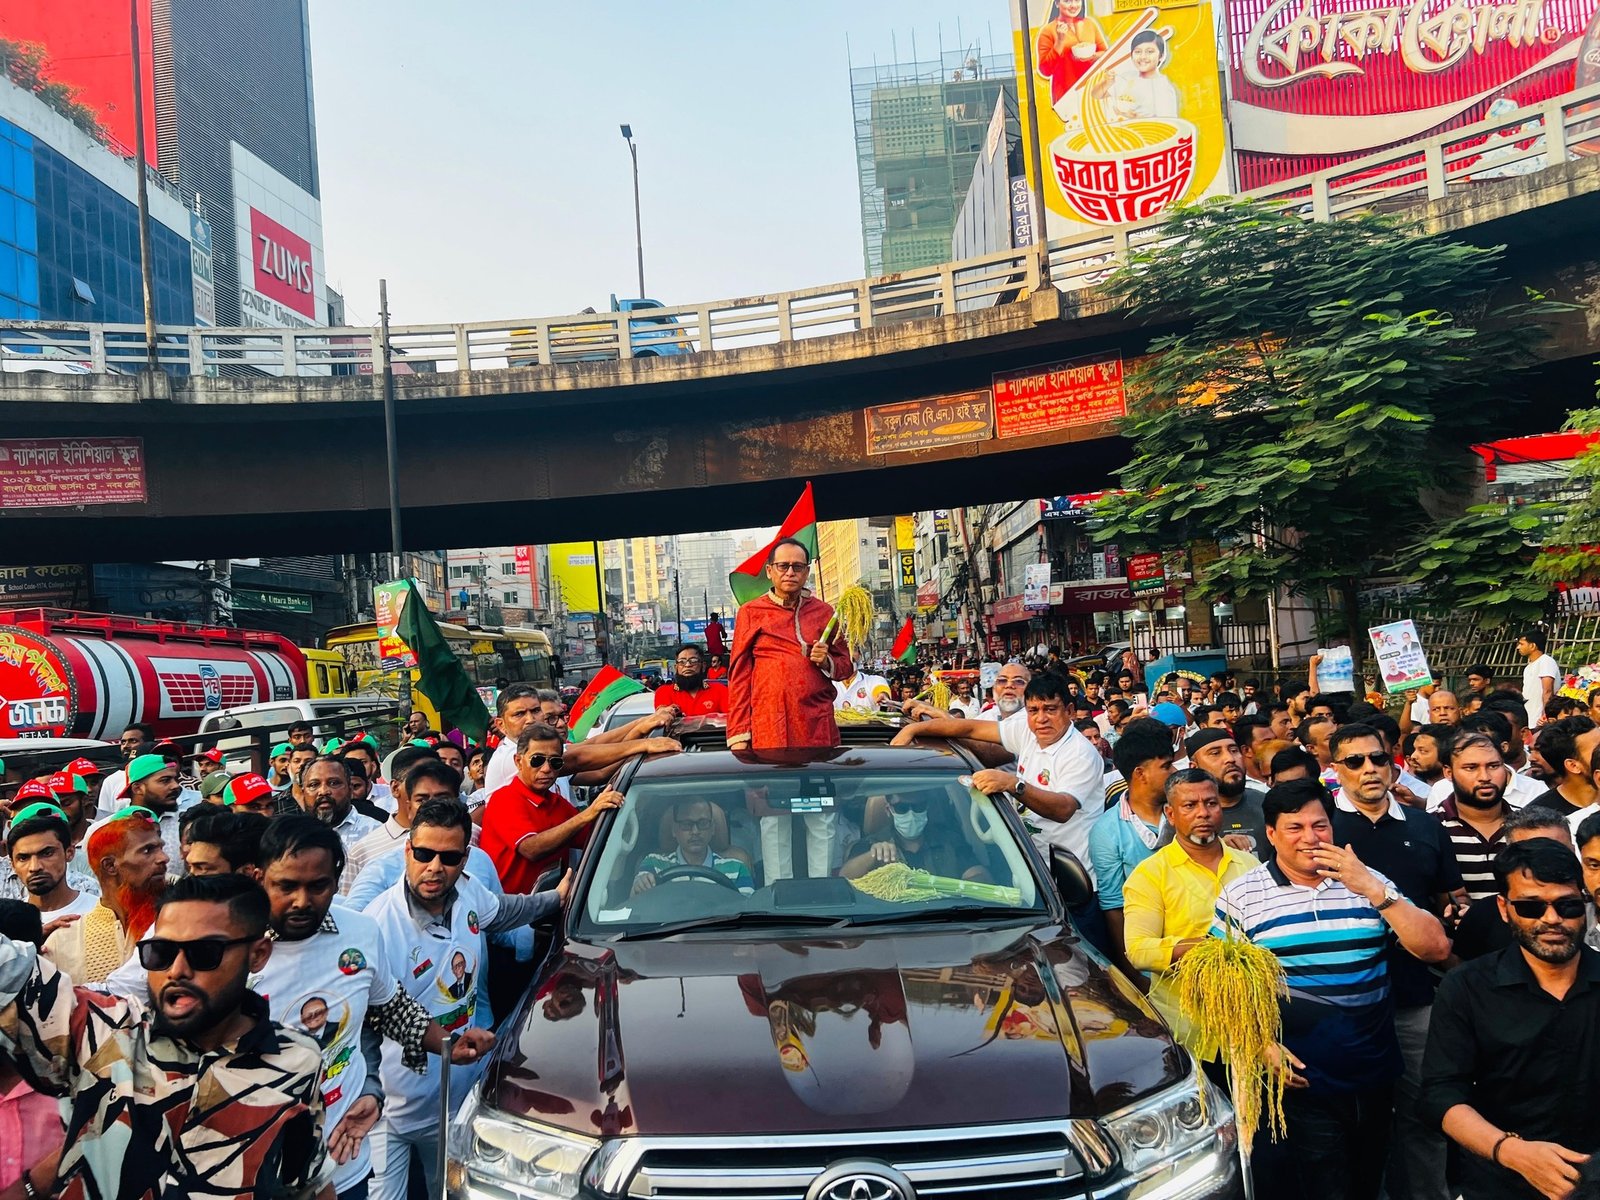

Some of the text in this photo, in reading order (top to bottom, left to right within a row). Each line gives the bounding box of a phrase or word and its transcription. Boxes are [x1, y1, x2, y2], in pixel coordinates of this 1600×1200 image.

[1053, 134, 1193, 196] সবার জন্যই
[1011, 178, 1028, 212] হোটেল
[1061, 170, 1190, 223] ভালো
[258, 233, 312, 294] ZUMS
[241, 289, 271, 316] ZNRF
[1008, 374, 1048, 396] ন্যাশনাল
[1048, 361, 1097, 389] ইনিশিয়াল
[1098, 360, 1117, 381] স্কুল
[883, 415, 902, 431] বকুল
[955, 403, 970, 420] হাই
[971, 402, 987, 419] স্কুল
[12, 442, 139, 466] ন্যাশনাল ইনিশিয়াল স্কুল
[93, 472, 112, 480] ভর্তি
[901, 556, 915, 585] GYM
[268, 595, 287, 605] Uttara
[287, 597, 301, 605] Bank
[1134, 587, 1165, 597] WALTON
[19, 731, 50, 739] JET-A-1
